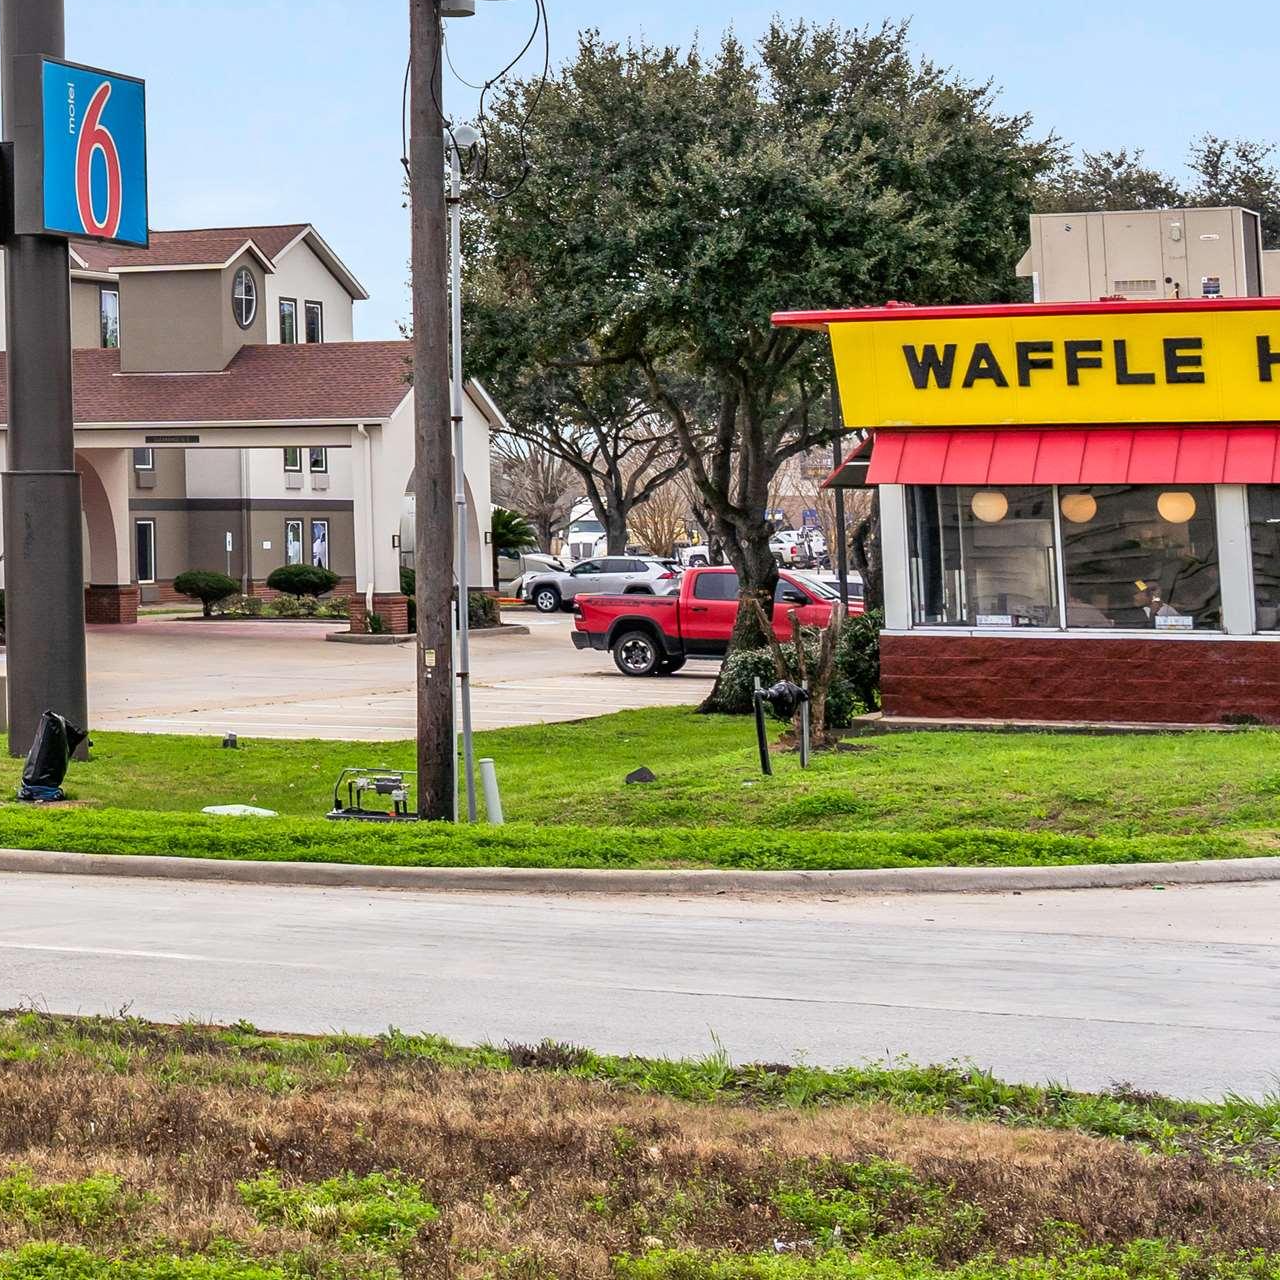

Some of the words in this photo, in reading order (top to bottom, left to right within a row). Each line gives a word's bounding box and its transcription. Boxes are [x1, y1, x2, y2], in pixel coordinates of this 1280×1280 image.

[67, 81, 76, 135] motel
[75, 80, 122, 239] 6
[902, 337, 1206, 390] WAFFLE
